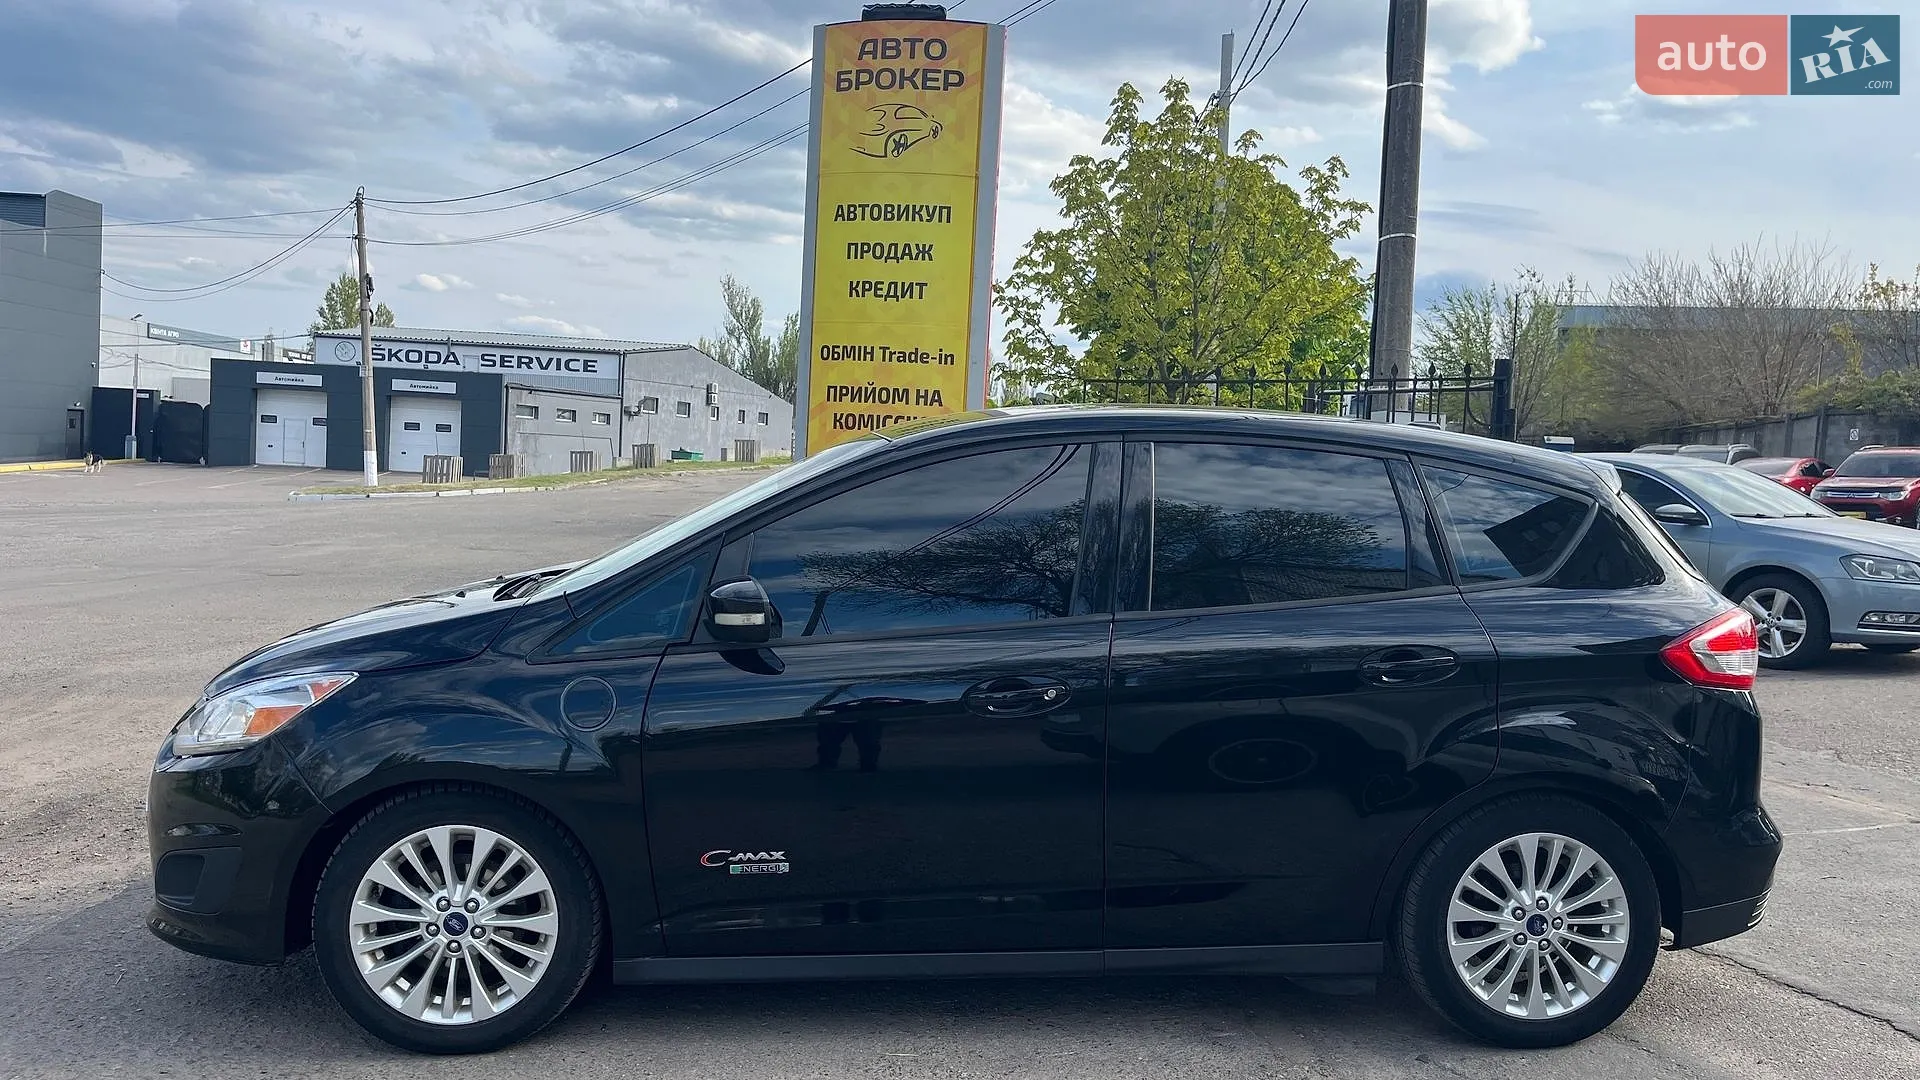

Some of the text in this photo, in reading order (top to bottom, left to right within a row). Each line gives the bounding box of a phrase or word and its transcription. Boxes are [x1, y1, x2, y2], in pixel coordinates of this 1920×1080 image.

[858, 37, 947, 61] АВТО
[836, 67, 965, 92] БРОКЕР
[834, 203, 952, 223] АВТОВИКУП
[847, 242, 933, 263] ПРОДАЖ
[848, 280, 928, 302] КРЕДИТ
[371, 344, 598, 373] ŠKODA SERVICE
[820, 345, 955, 365] ОБМІН Trade-in
[826, 382, 944, 407] ПРИЙОМ НА
